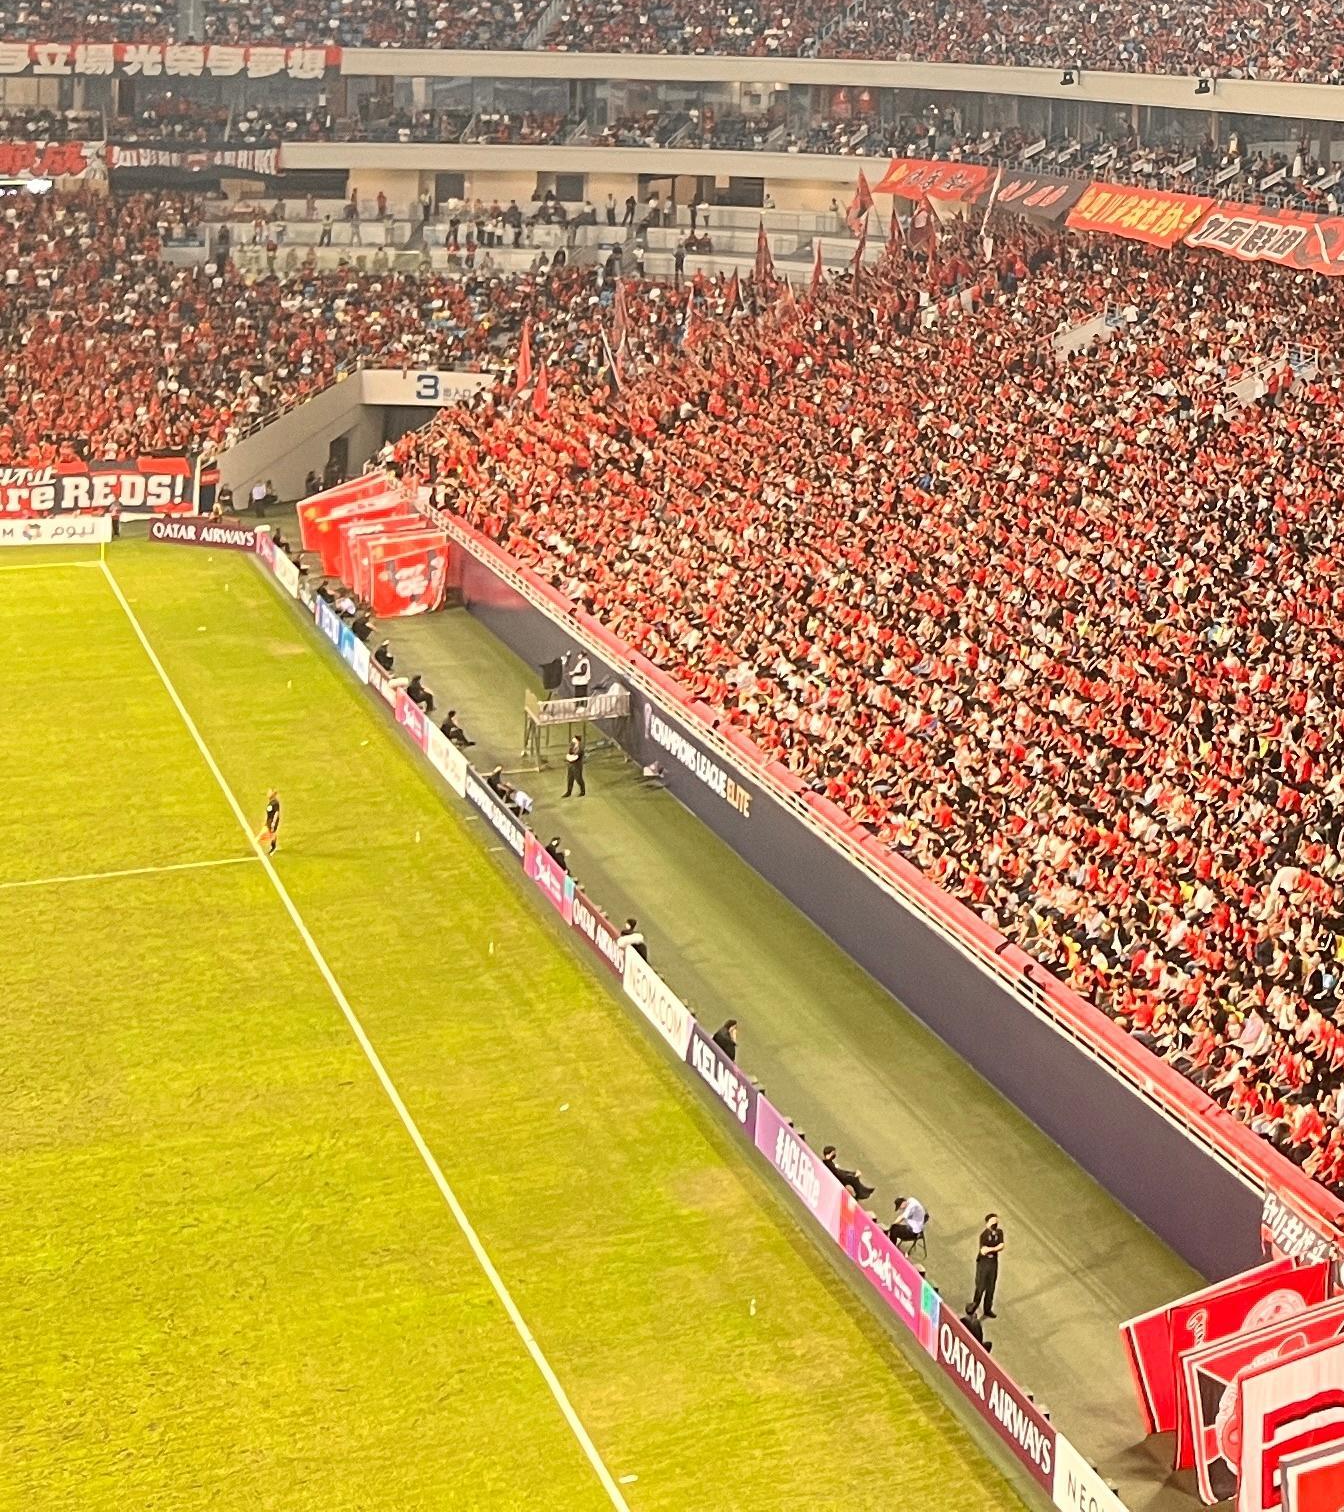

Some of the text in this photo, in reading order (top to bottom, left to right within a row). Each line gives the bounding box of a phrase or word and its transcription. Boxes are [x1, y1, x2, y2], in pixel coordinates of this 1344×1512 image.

[416, 374, 440, 400] 3
[0, 473, 183, 512] re REDS!
[152, 521, 196, 540] QATAR
[200, 526, 255, 547] AIRWAYS
[726, 777, 752, 818] ELITE
[692, 1033, 739, 1113] KELME
[940, 1323, 1052, 1475] QATAR AIRWAYS
